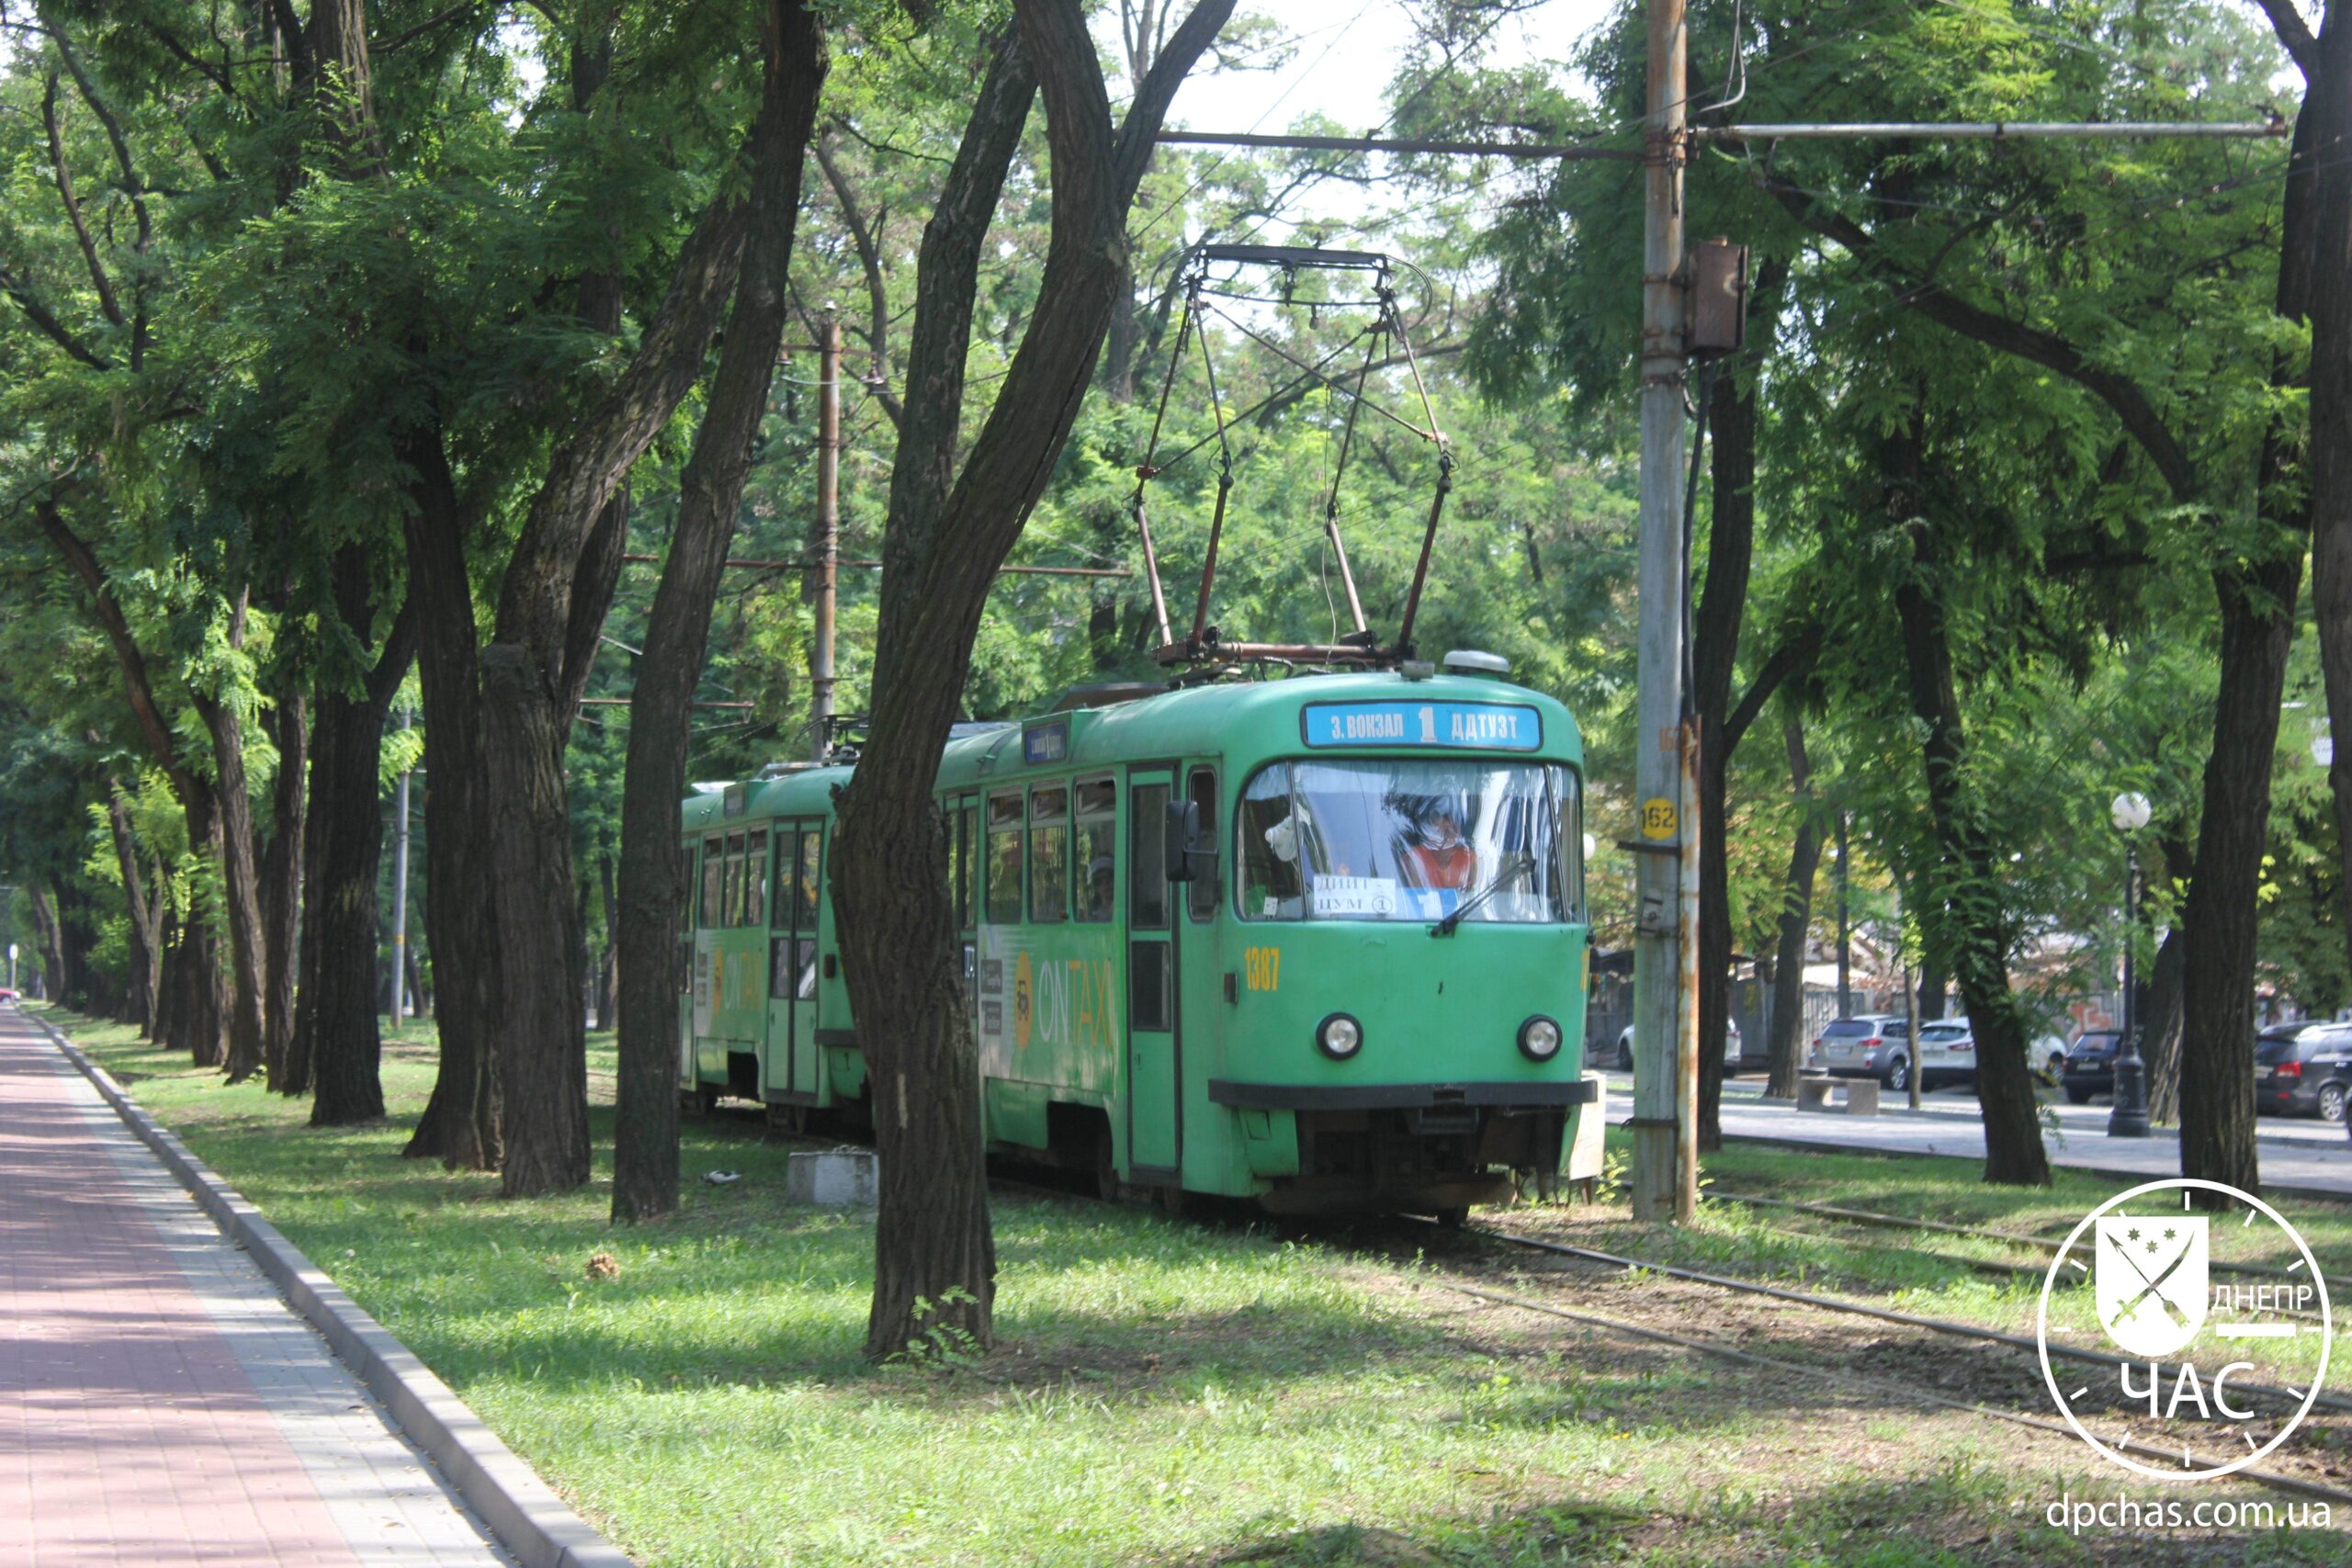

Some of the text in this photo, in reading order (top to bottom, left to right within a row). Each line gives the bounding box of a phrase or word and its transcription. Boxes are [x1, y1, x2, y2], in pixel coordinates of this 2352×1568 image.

[1347, 713, 1404, 739] ВОКЗАЛ
[1418, 706, 1438, 742] 1
[1451, 713, 1518, 740] ДДТУЗТ
[1642, 807, 1674, 829] 162
[1319, 898, 1362, 910] ЦУМ
